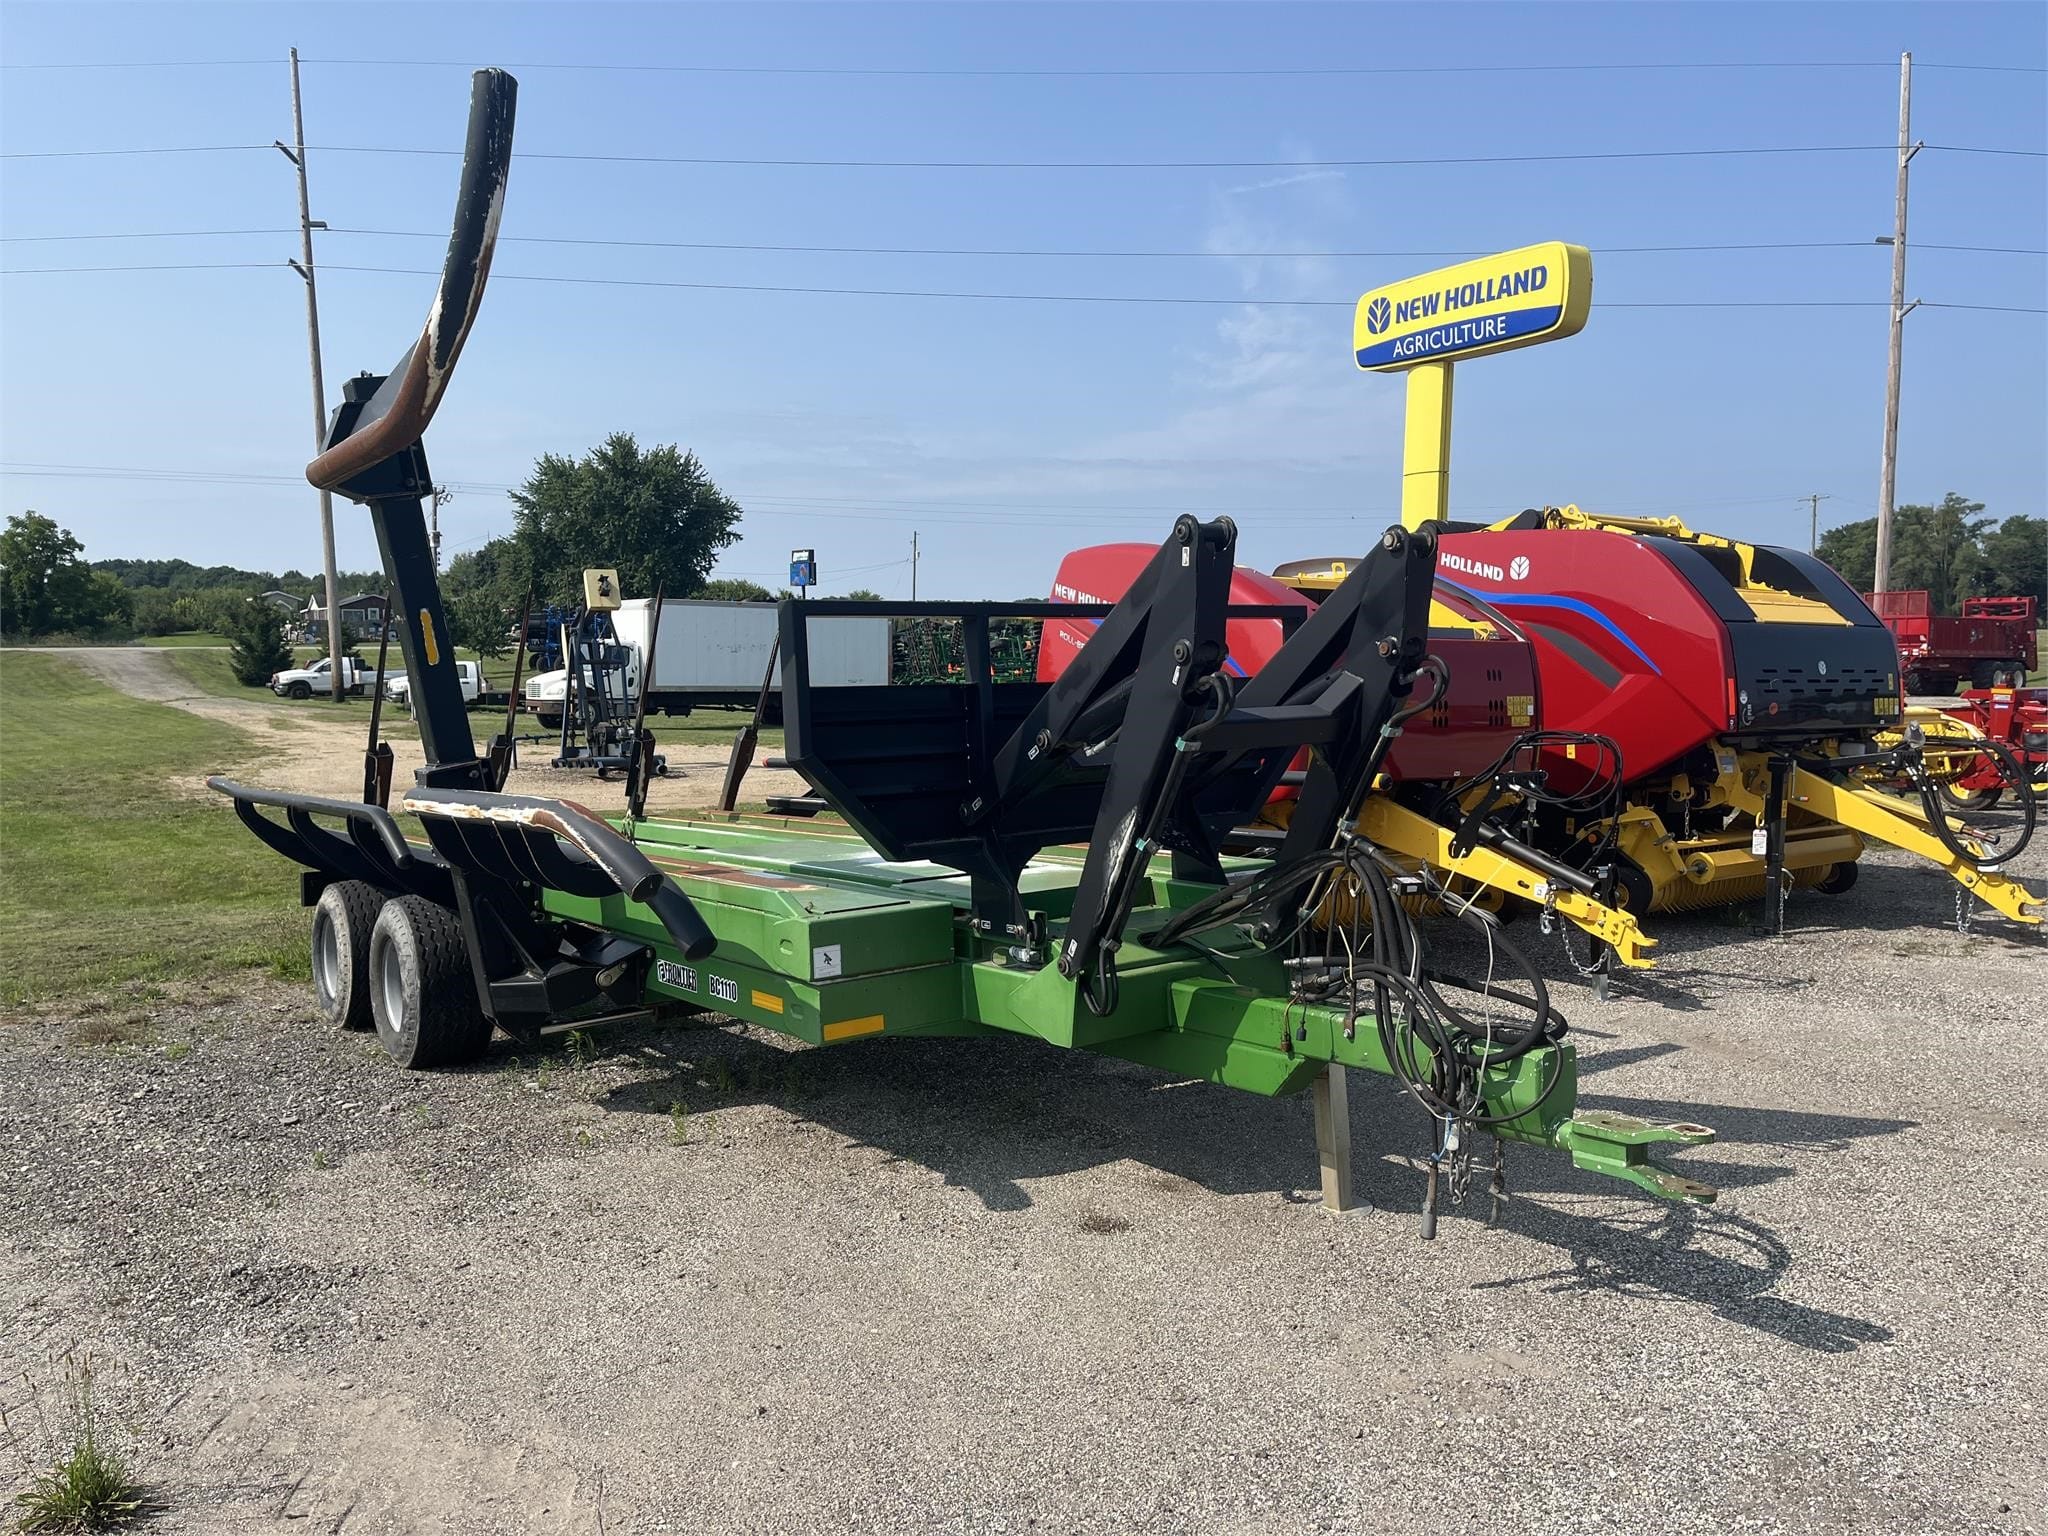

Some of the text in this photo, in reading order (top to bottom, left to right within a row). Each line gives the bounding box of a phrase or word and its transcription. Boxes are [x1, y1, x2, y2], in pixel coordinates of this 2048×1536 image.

[1395, 265, 1548, 324] NEW HOLLAND
[1393, 316, 1506, 358] AGRICULTURE
[1440, 552, 1504, 582] HOLLAND
[1055, 583, 1112, 604] NEW HOLL
[710, 976, 738, 1001] BC1110
